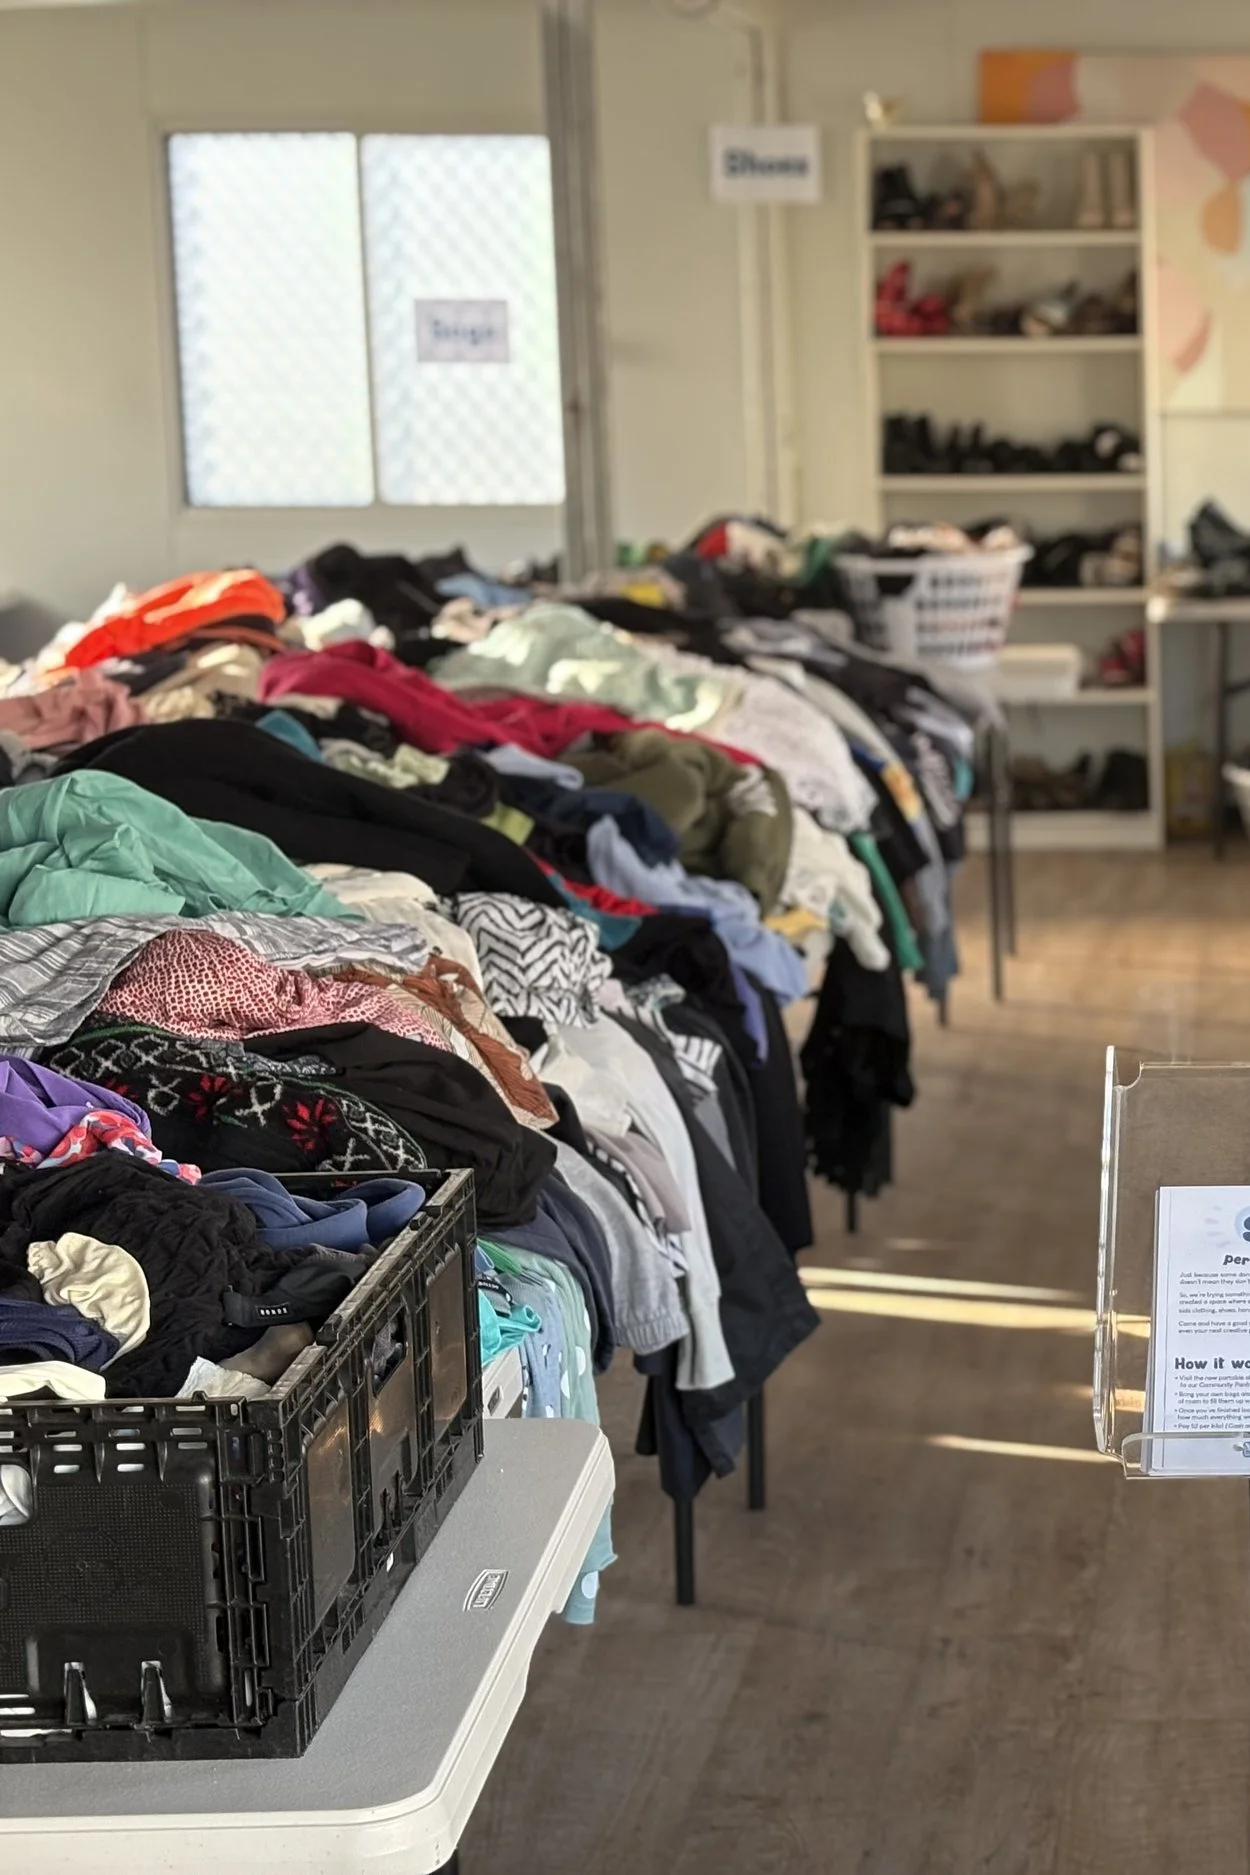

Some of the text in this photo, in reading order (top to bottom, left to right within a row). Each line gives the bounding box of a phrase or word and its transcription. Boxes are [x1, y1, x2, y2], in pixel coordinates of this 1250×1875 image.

[1222, 1255, 1250, 1265] per
[1175, 1357, 1208, 1369] How
[1214, 1357, 1225, 1369] it
